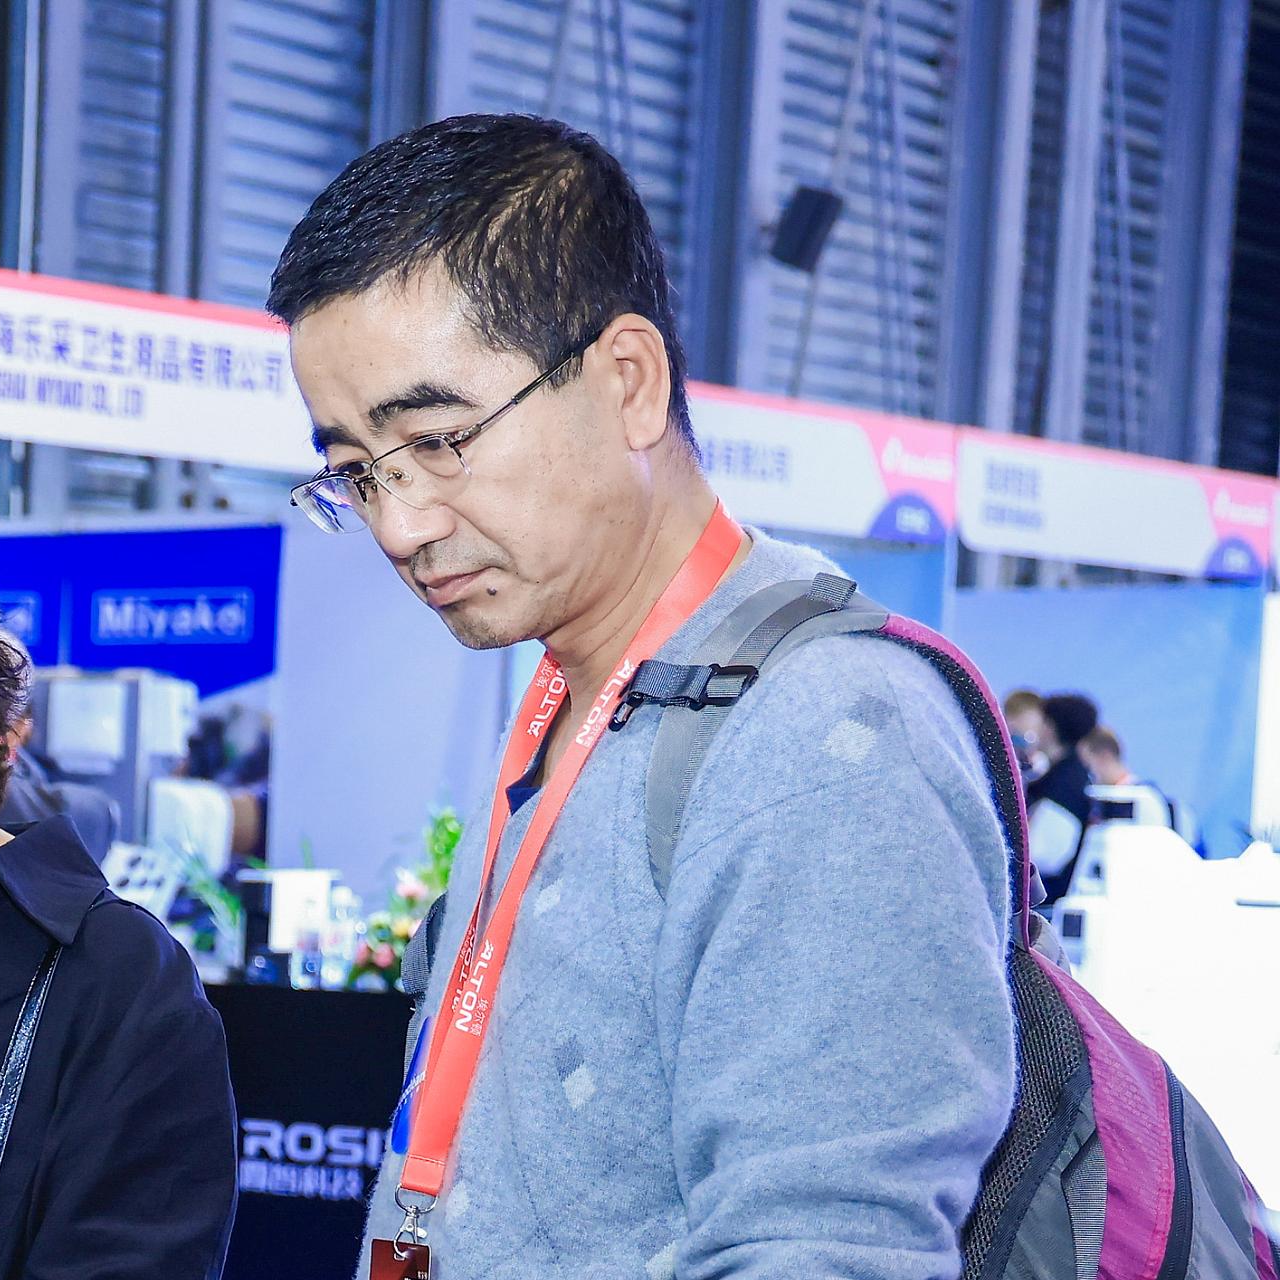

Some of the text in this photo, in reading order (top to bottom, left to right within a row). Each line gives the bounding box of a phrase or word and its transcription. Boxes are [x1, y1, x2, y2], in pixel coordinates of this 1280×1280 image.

[527, 669, 566, 738] ALTO
[575, 658, 635, 746] ALTON
[455, 939, 494, 1032] ALTON
